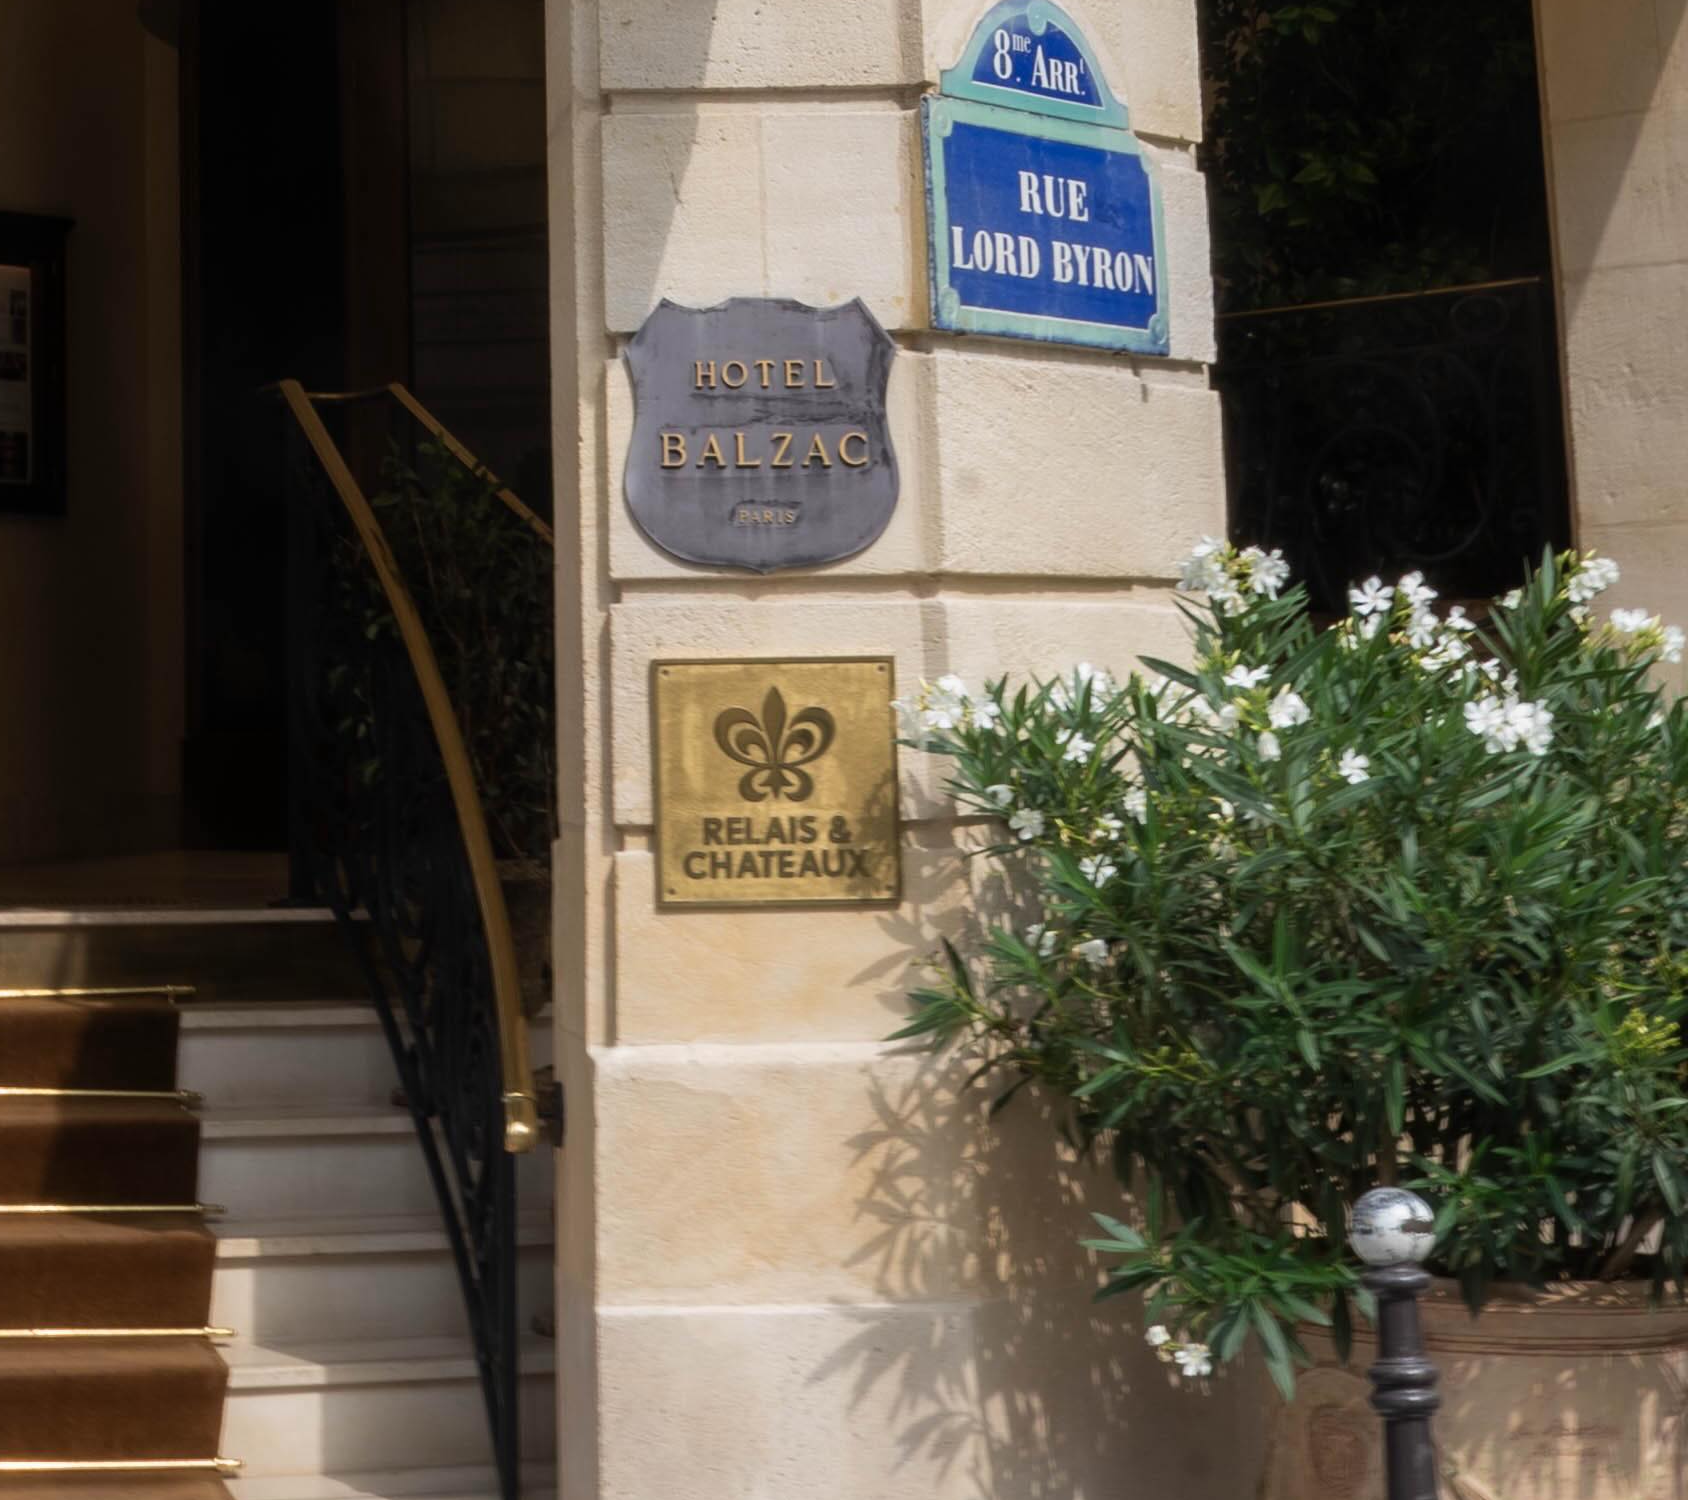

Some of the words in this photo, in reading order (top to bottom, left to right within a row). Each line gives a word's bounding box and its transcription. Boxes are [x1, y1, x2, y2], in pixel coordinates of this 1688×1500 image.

[1018, 171, 1089, 222] RUE
[951, 226, 1040, 279] LORD
[1052, 240, 1155, 296] BYRON
[694, 360, 837, 389] HOTEL
[659, 432, 871, 470] BALZAC
[738, 509, 795, 525] PARIS
[703, 815, 818, 846] RELAIS
[828, 814, 852, 845] &
[683, 849, 873, 881] CHATEAUX
